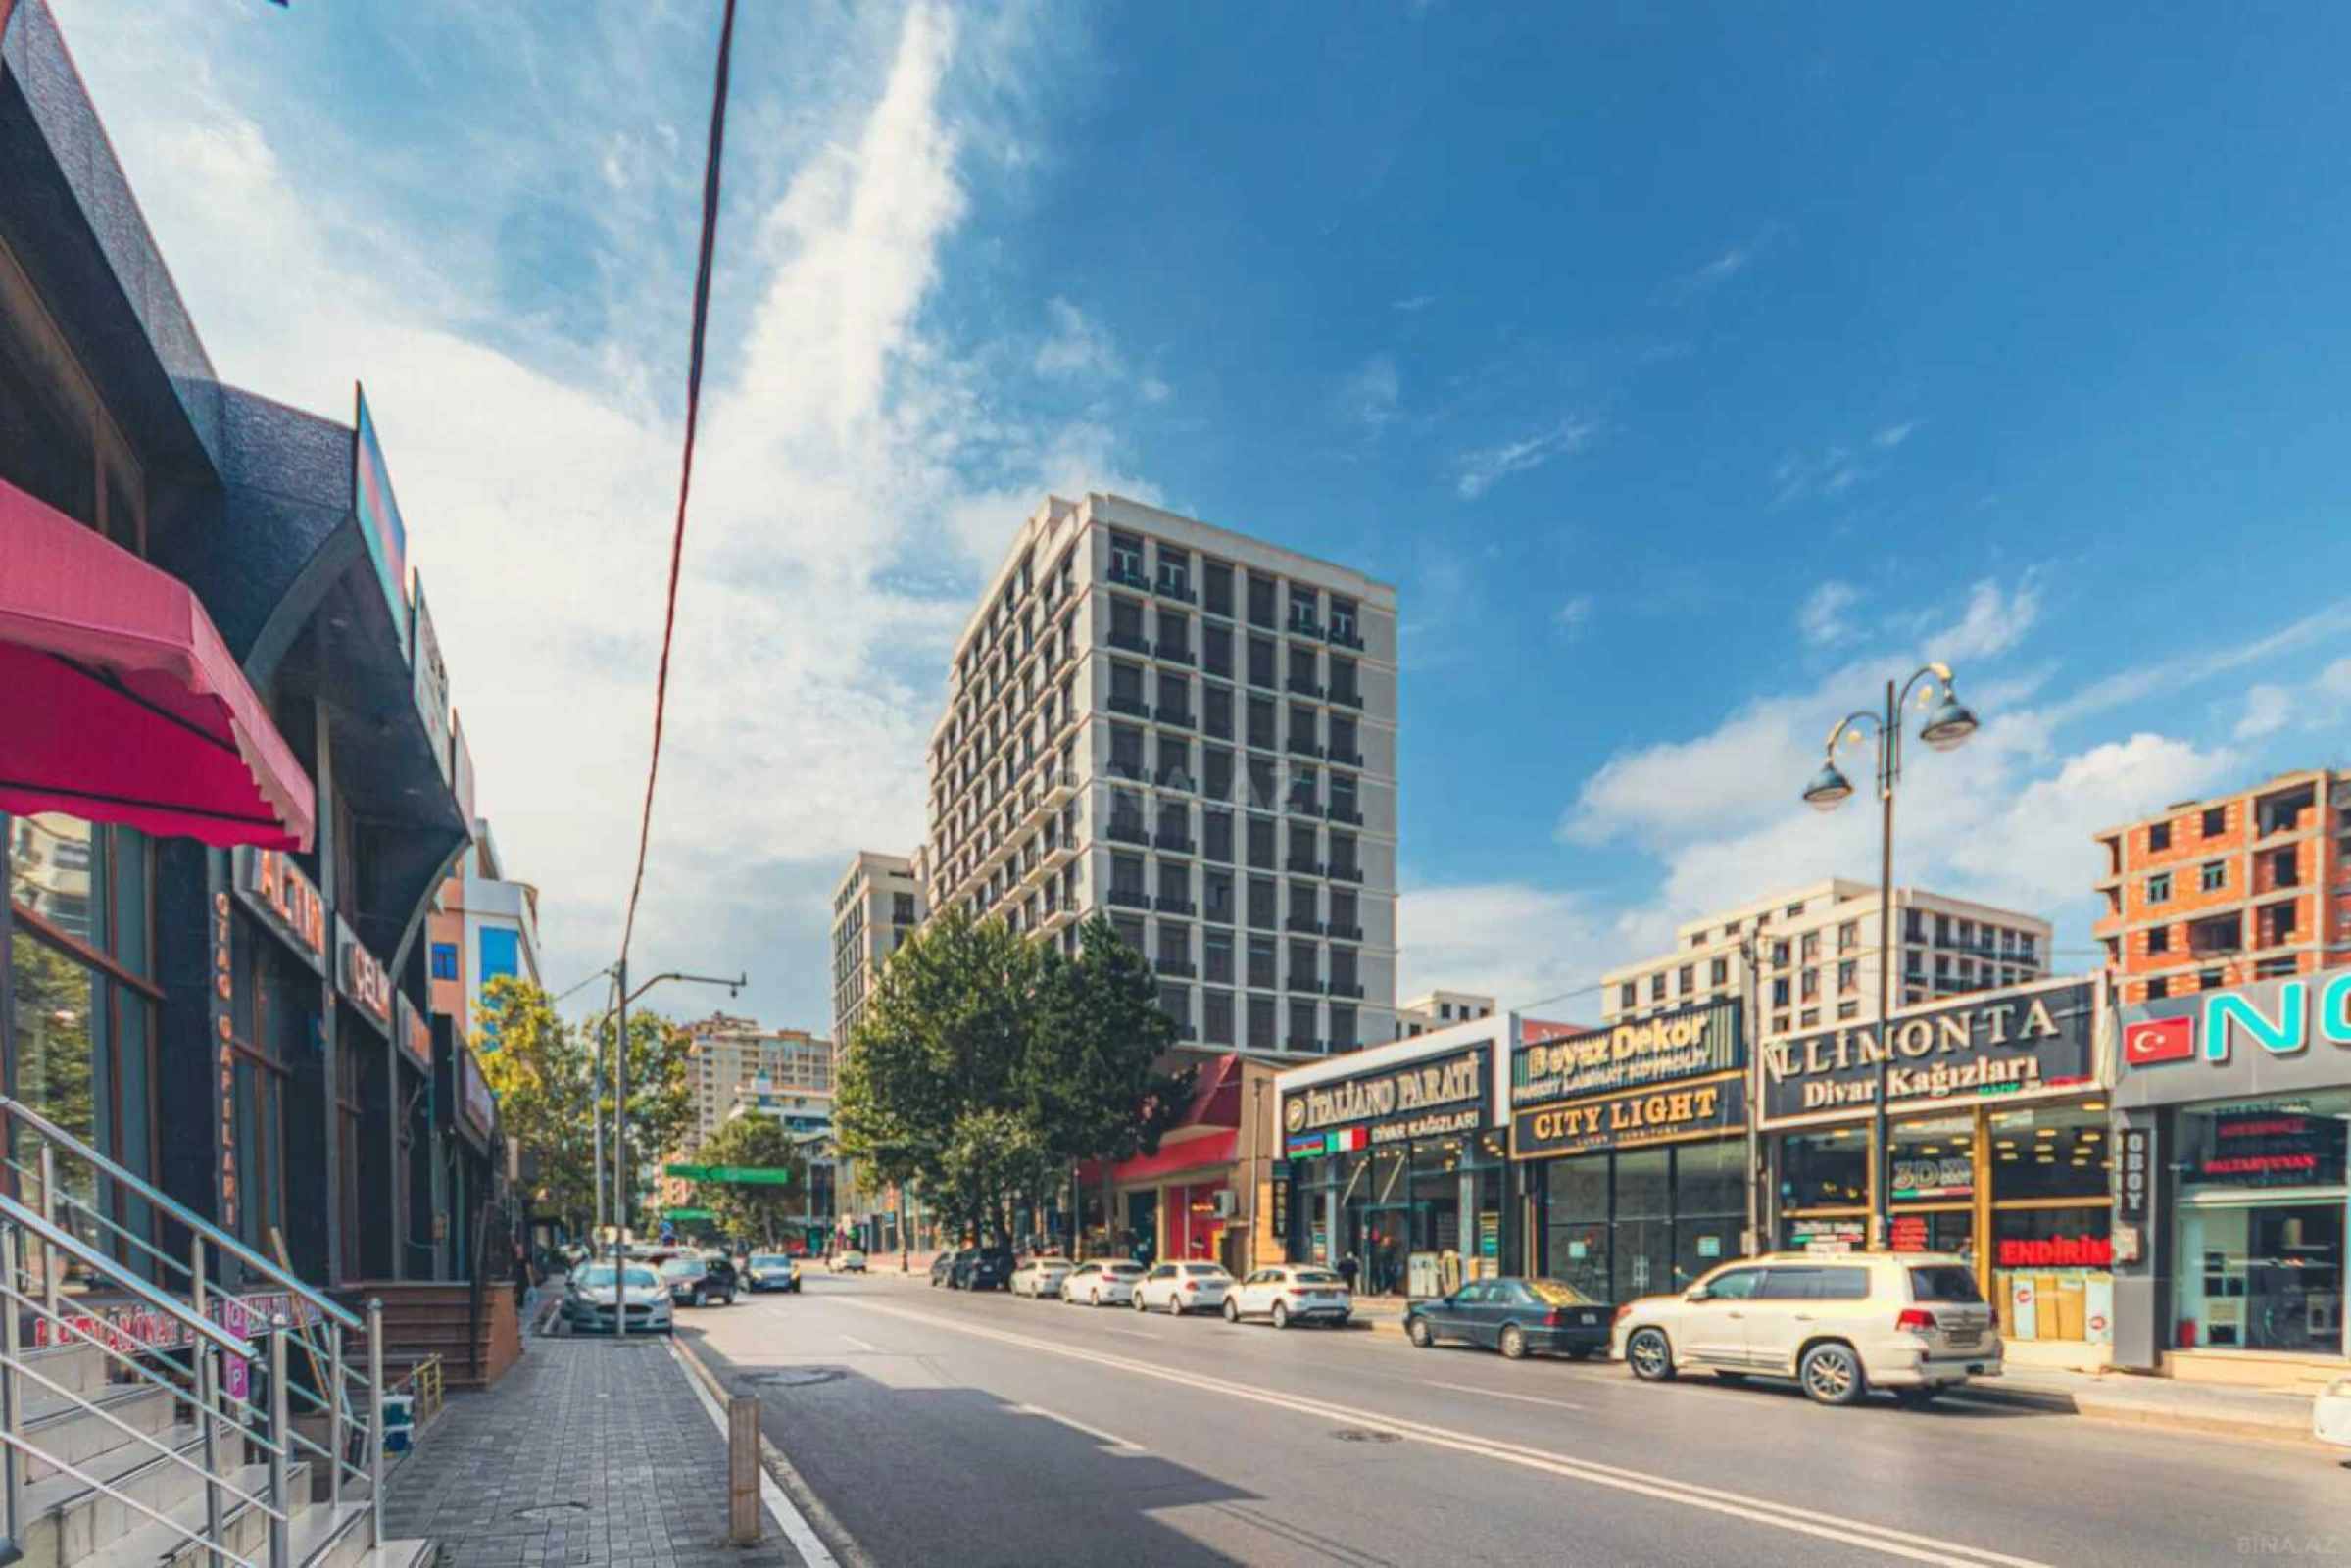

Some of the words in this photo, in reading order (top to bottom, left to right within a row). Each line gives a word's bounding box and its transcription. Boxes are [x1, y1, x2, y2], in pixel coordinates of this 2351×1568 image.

[1612, 1015, 1708, 1060] Dekor
[1804, 1079, 1877, 1107] Divar
[1887, 1054, 2039, 1097] Kağızları
[1533, 1105, 1602, 1140] CITY
[1610, 1088, 1718, 1129] LIGHT
[2127, 1132, 2144, 1210] OBOY
[1998, 1233, 2115, 1266] ENDİRİM
